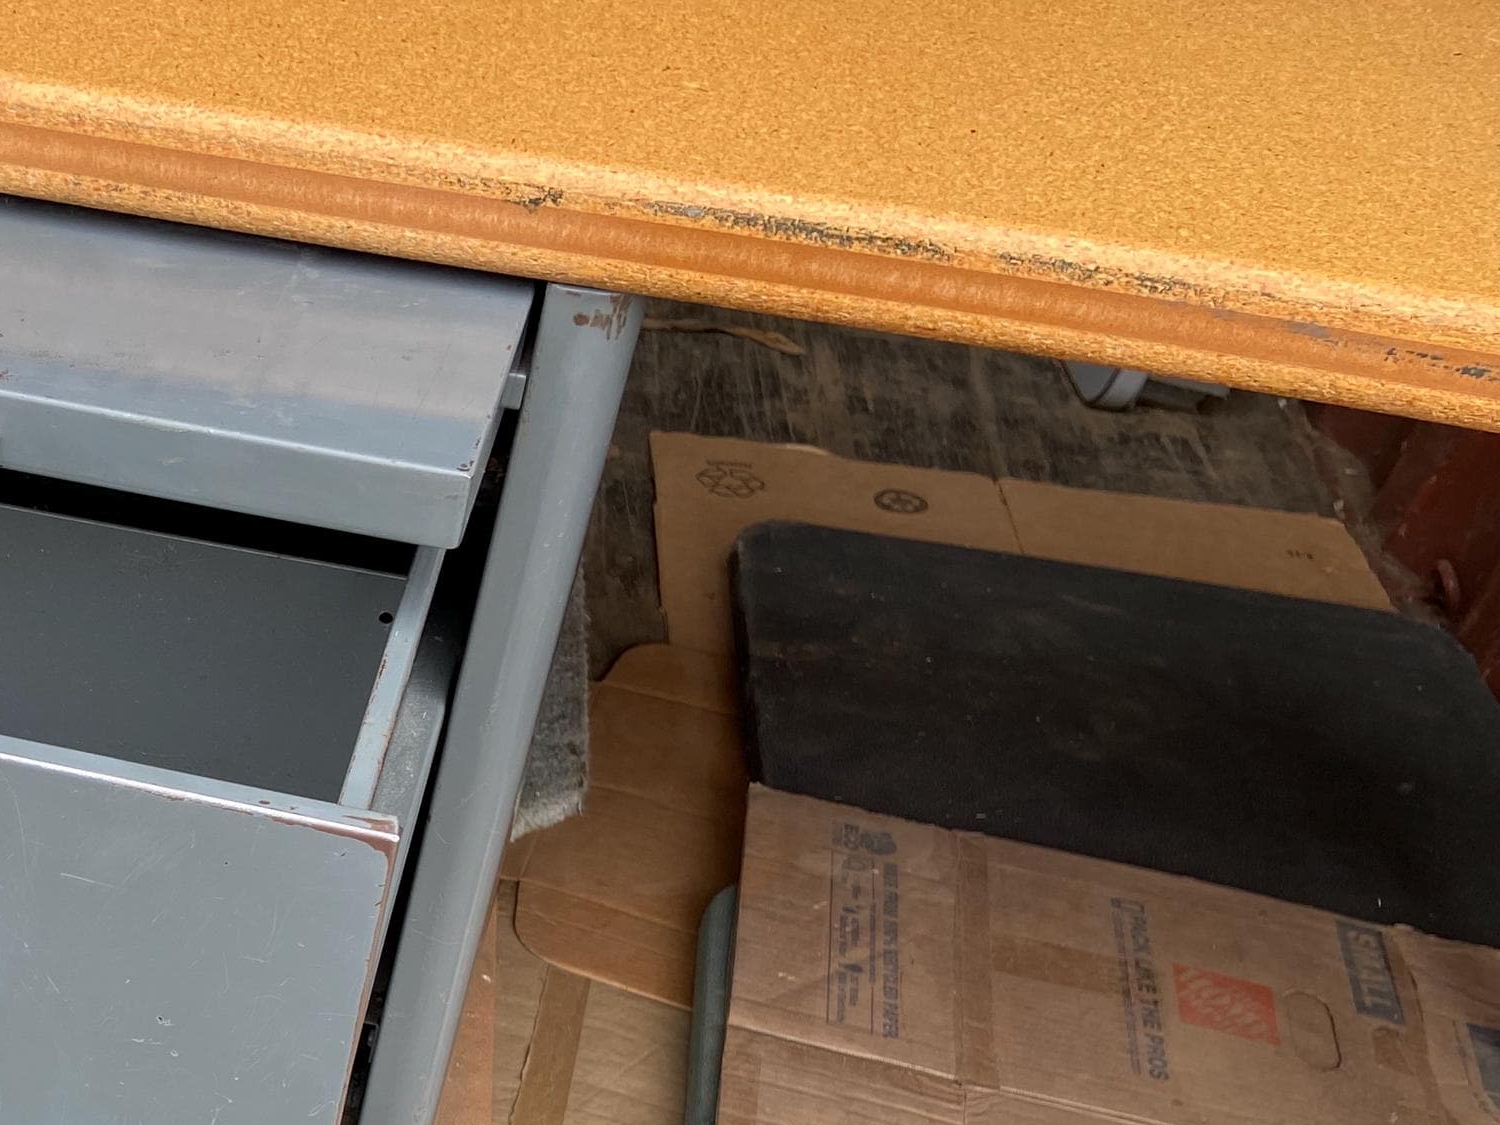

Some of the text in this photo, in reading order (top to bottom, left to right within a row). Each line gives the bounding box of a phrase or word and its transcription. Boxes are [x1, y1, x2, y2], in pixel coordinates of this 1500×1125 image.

[1348, 928, 1393, 1008] SMALL
[1140, 998, 1162, 1031] THE
[1144, 1031, 1169, 1081] PROS
